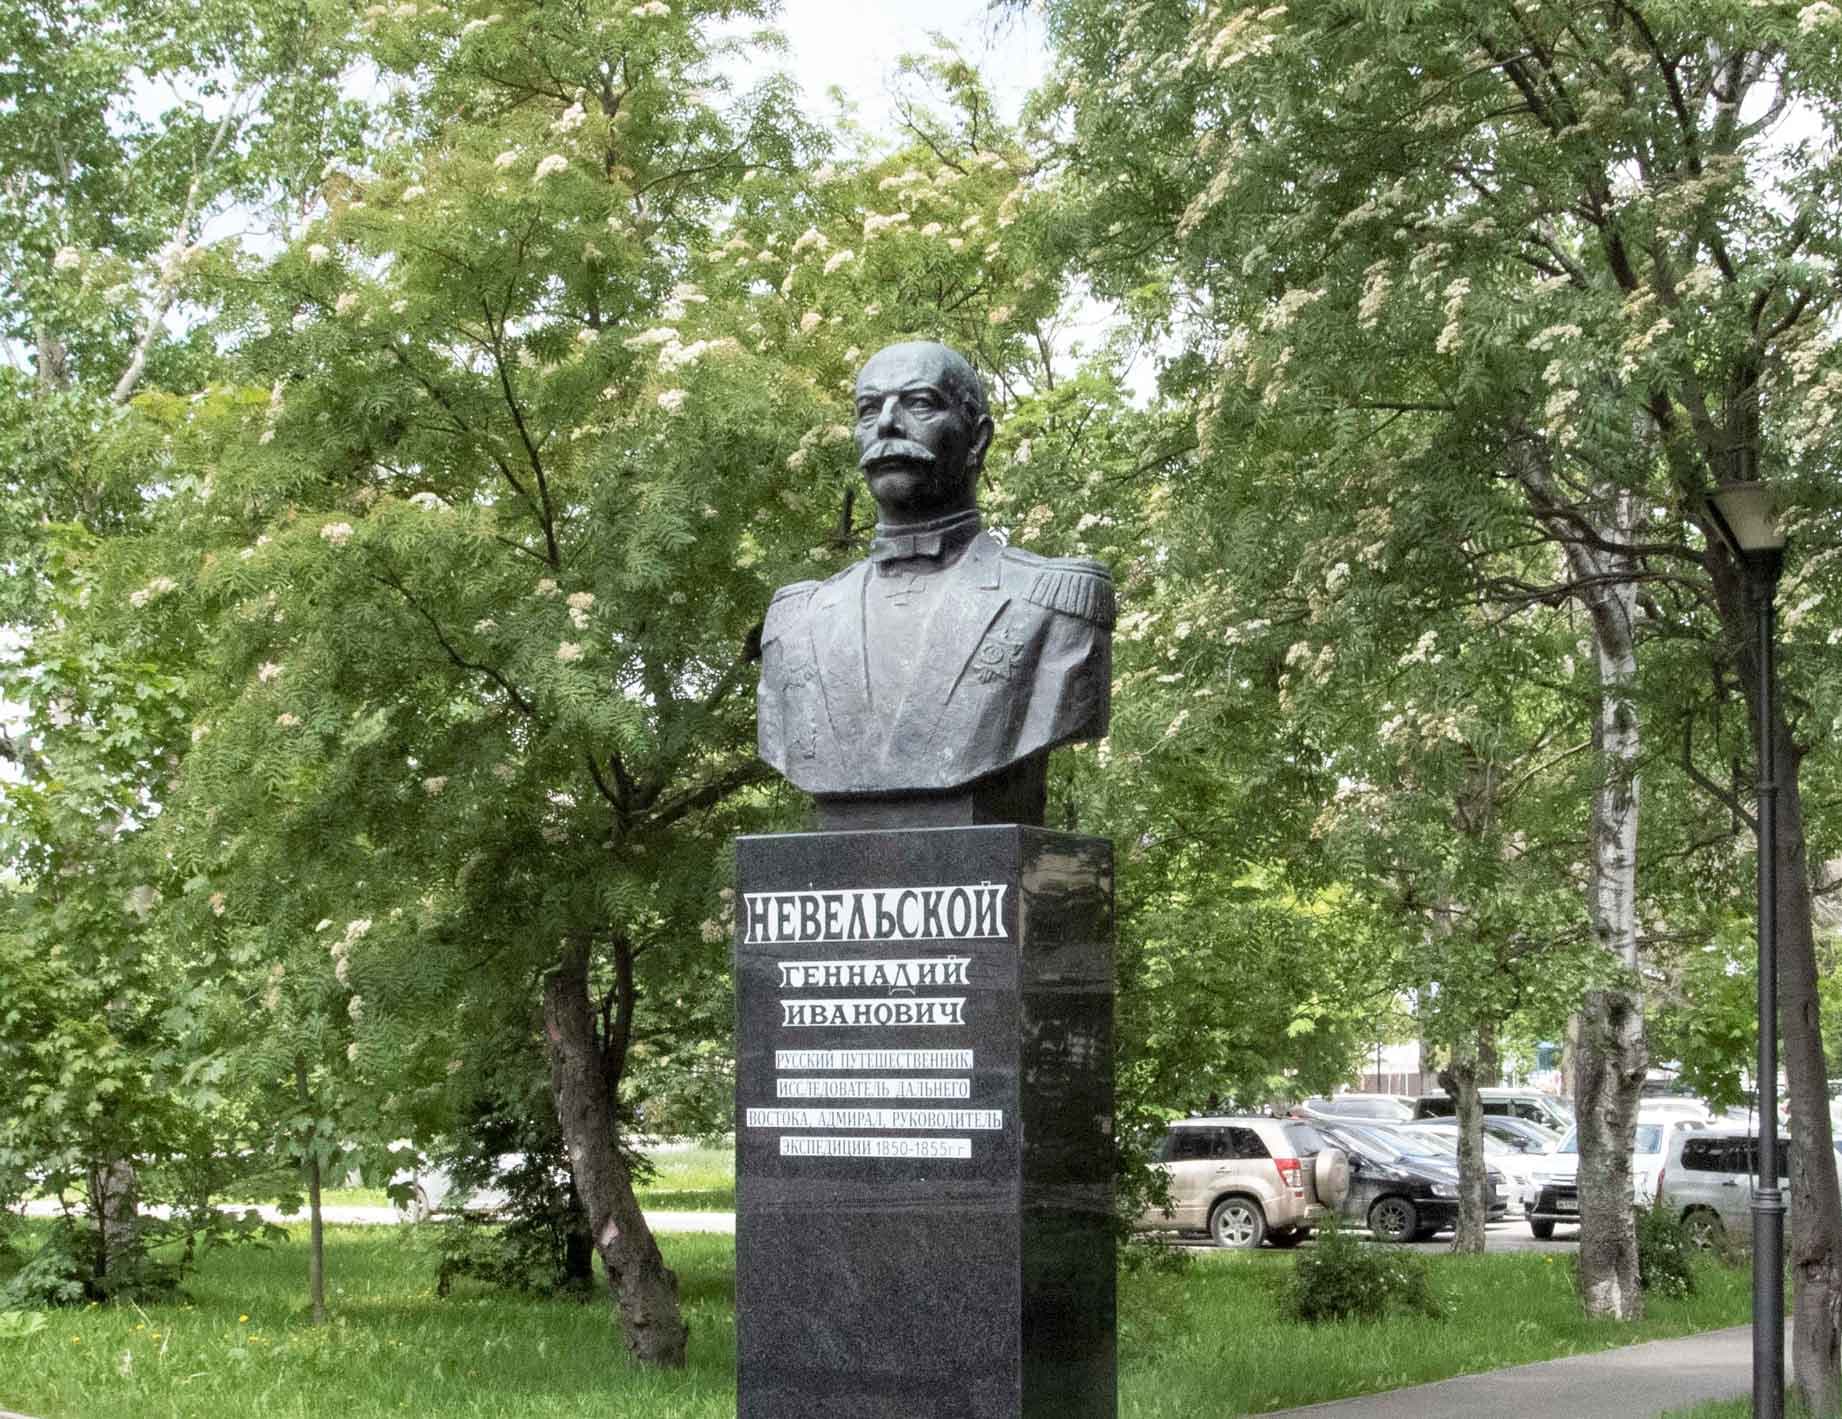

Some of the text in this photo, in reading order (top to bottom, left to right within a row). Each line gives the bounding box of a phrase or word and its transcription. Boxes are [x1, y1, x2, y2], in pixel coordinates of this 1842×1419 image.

[749, 882, 1001, 942] НЕВЕЛЬСКОЙ
[783, 956, 963, 995] ГЕННАДИЙ
[785, 1003, 960, 1025] ИВАНОВИЧ
[777, 1052, 833, 1068] РУССКИЙ
[779, 1081, 968, 1097] ИССЛЕДОВАТЕЛЬ ДАЛЬНЕГО
[892, 1112, 1001, 1129] РУКОВОДИТЕЛЬ
[782, 1139, 871, 1156] ЭКСПЕДИЦИИ
